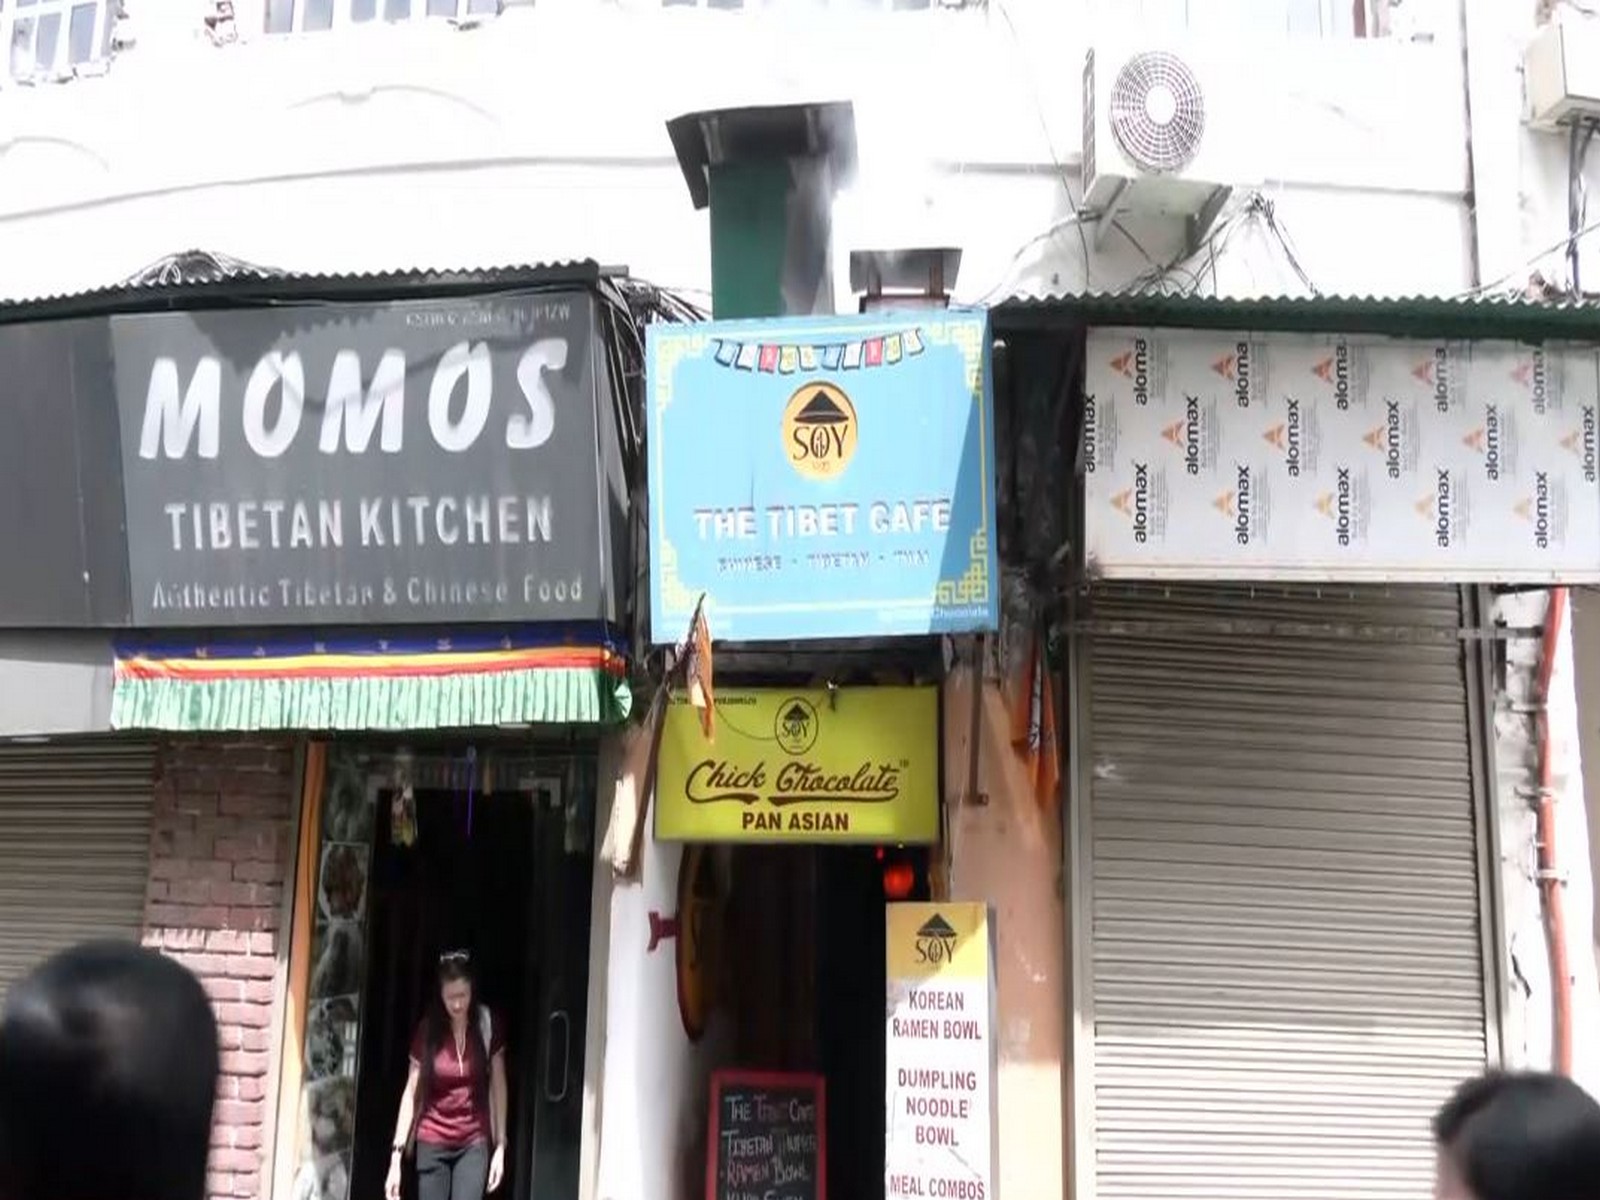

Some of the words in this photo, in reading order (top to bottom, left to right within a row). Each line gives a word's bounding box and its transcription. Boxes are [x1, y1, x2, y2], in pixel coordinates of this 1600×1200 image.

[138, 338, 568, 459] MOMOS
[1133, 338, 1147, 405] aloma
[1235, 342, 1249, 408] aloma
[1334, 345, 1348, 410] aloma
[1434, 347, 1448, 412] aloma
[1532, 350, 1545, 415] aloma
[793, 425, 849, 461] SOY
[1083, 394, 1096, 474] alomax
[1184, 396, 1199, 475] alomax
[1285, 398, 1300, 478] alomax
[1386, 400, 1400, 480] alomax
[1485, 403, 1499, 482] alomax
[1581, 406, 1596, 484] alomax
[164, 498, 344, 551] TIBETAN
[359, 496, 554, 546] KITCHEN
[693, 507, 757, 541] THE
[766, 503, 859, 539] TIBET
[870, 498, 952, 534] CAFE
[1133, 463, 1148, 544] alomax
[1235, 465, 1250, 546] alomax
[1336, 468, 1350, 547] alomax
[1436, 469, 1450, 548] alomax
[1534, 471, 1548, 550] alomax
[278, 577, 374, 607] Tibetan
[383, 577, 398, 606] &
[407, 577, 508, 605] Chinese
[524, 573, 583, 603] Food
[782, 722, 810, 739] SOY
[685, 759, 766, 803] Chick
[770, 761, 899, 804] Chocolate
[742, 812, 782, 831] PAN
[788, 812, 850, 831] ASIAN
[915, 938, 958, 964] SOY
[892, 1017, 939, 1040] RAMEN
[943, 1020, 982, 1040] BOWL
[908, 990, 965, 1011] KOREAN
[724, 1095, 752, 1122] THE
[898, 1068, 977, 1092] DUMPLING
[906, 1097, 969, 1119] NOODLE
[915, 1125, 960, 1147] BOWL
[890, 1174, 925, 1197] MEAL
[929, 1178, 985, 1200] COMBOS
